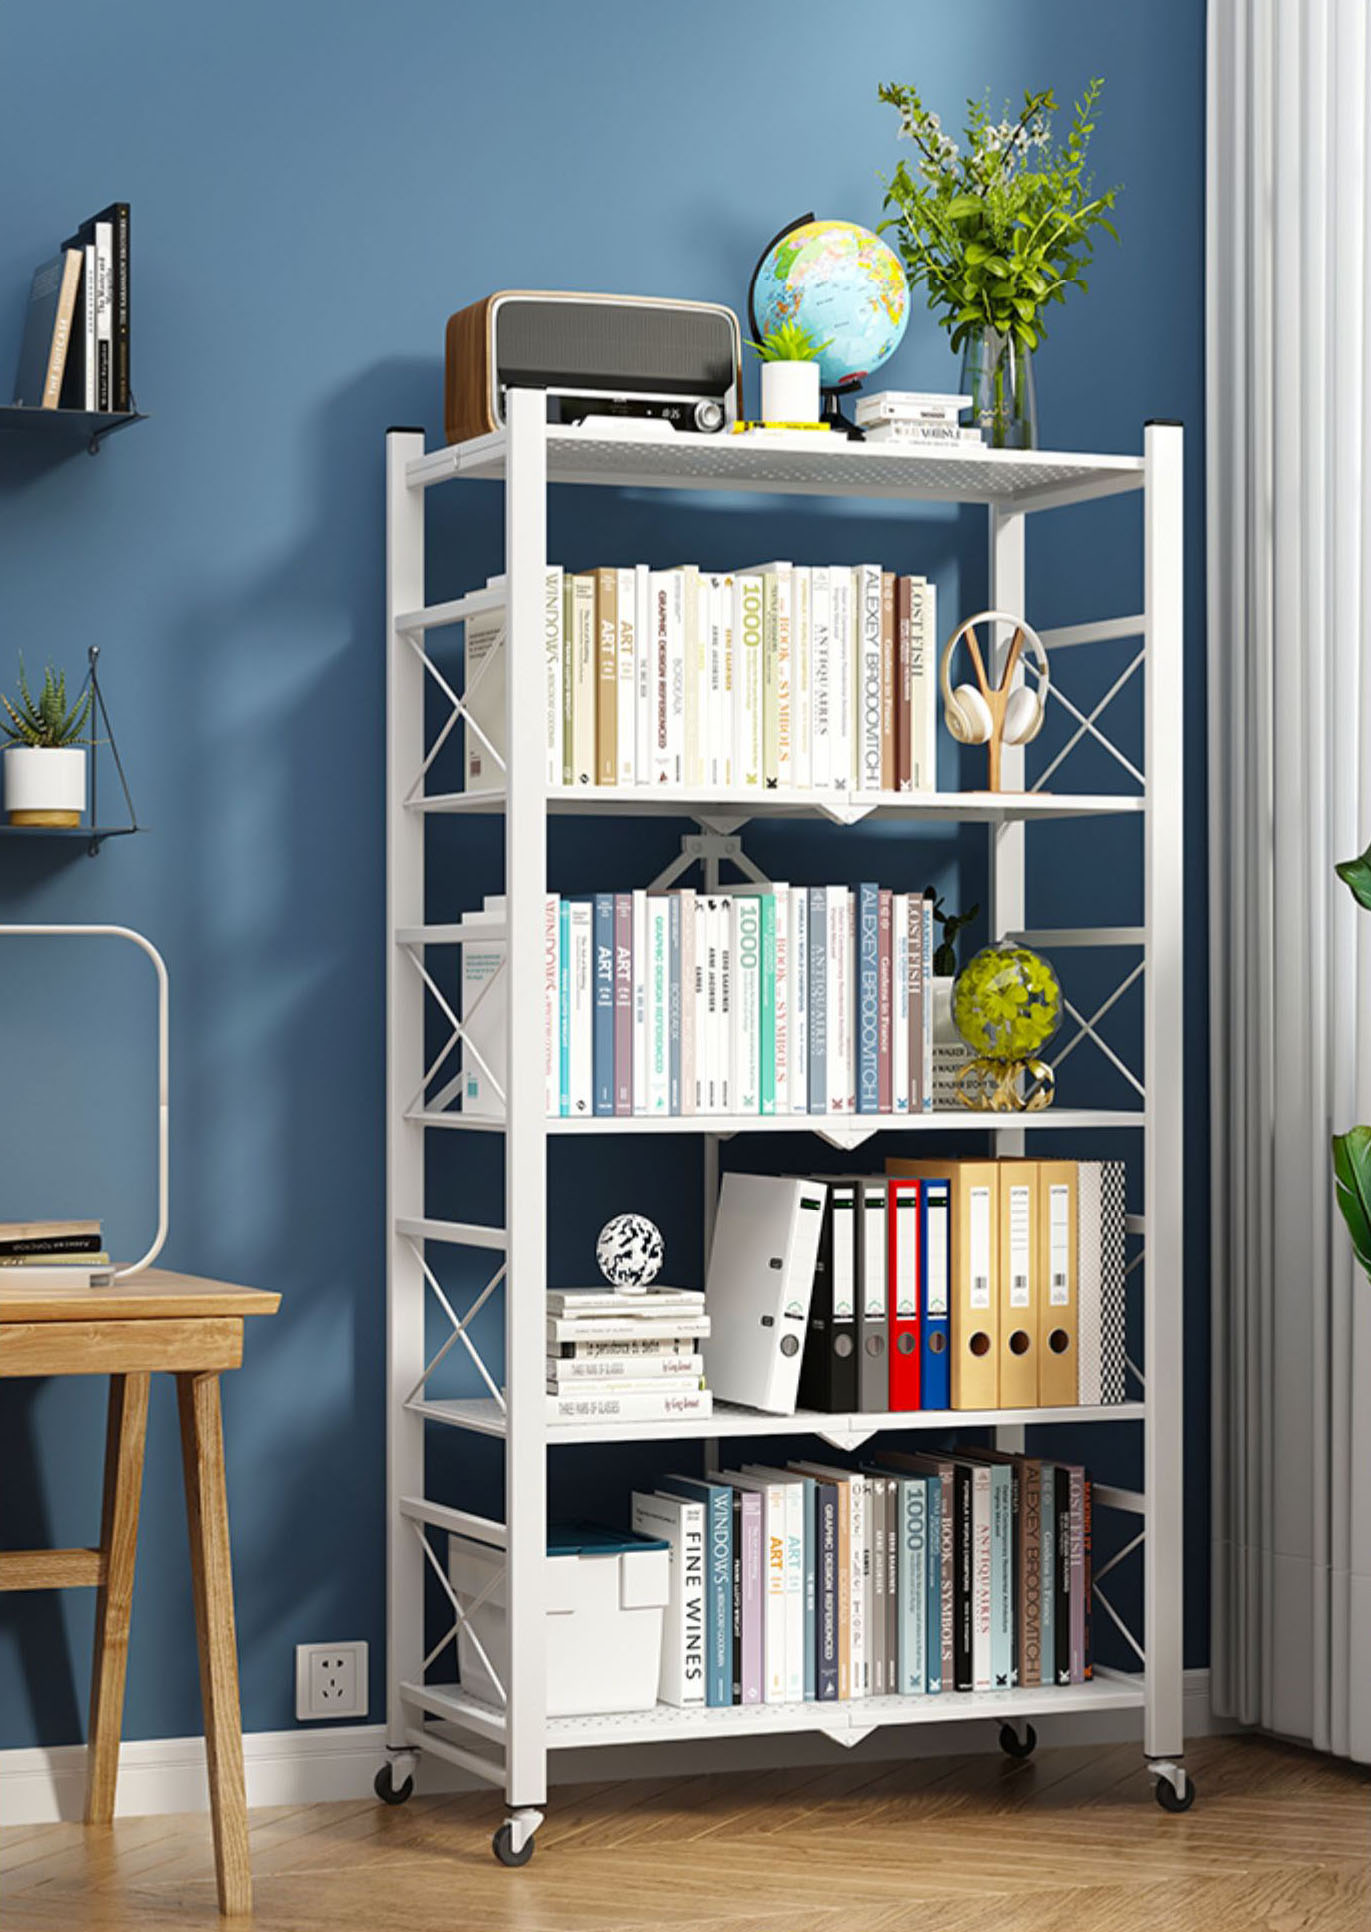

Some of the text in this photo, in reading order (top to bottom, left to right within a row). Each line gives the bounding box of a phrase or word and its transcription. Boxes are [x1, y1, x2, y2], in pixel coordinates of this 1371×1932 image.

[546, 573, 559, 663] WINDOWS
[601, 619, 615, 656] ART
[621, 620, 633, 656] ART
[744, 584, 760, 647] 1000
[912, 582, 923, 678] LOST FISH
[658, 640, 667, 678] DESIGN
[817, 624, 828, 736] ANTIQUAIRES
[866, 570, 879, 781] ALEXEY BRODOVITCH
[779, 680, 790, 762] SYMBOLS
[545, 900, 556, 991] WINDOWS
[598, 946, 612, 982] ART
[617, 946, 631, 982] ART
[740, 906, 757, 969] 1000
[908, 900, 921, 994] LOST FISH
[655, 965, 664, 1003] DESIGN
[813, 946, 825, 1056] ANTIQUAIRES
[862, 888, 876, 1098] ALEXEY BRODOVITCH
[714, 1493, 729, 1584] WINDOWS
[770, 1536, 783, 1570] ART
[788, 1536, 801, 1570] ART
[907, 1488, 924, 1551] 1000
[941, 1517, 953, 1564] BOOK
[1071, 1472, 1083, 1568] LOST FISH
[686, 1532, 701, 1680] FINE WINES
[825, 1552, 834, 1590] DESIGN
[979, 1524, 990, 1634] ANTIQUAIRES
[1026, 1467, 1040, 1672] ALEXEY BRODOVITCH
[941, 1579, 953, 1661] SYMBOLS
